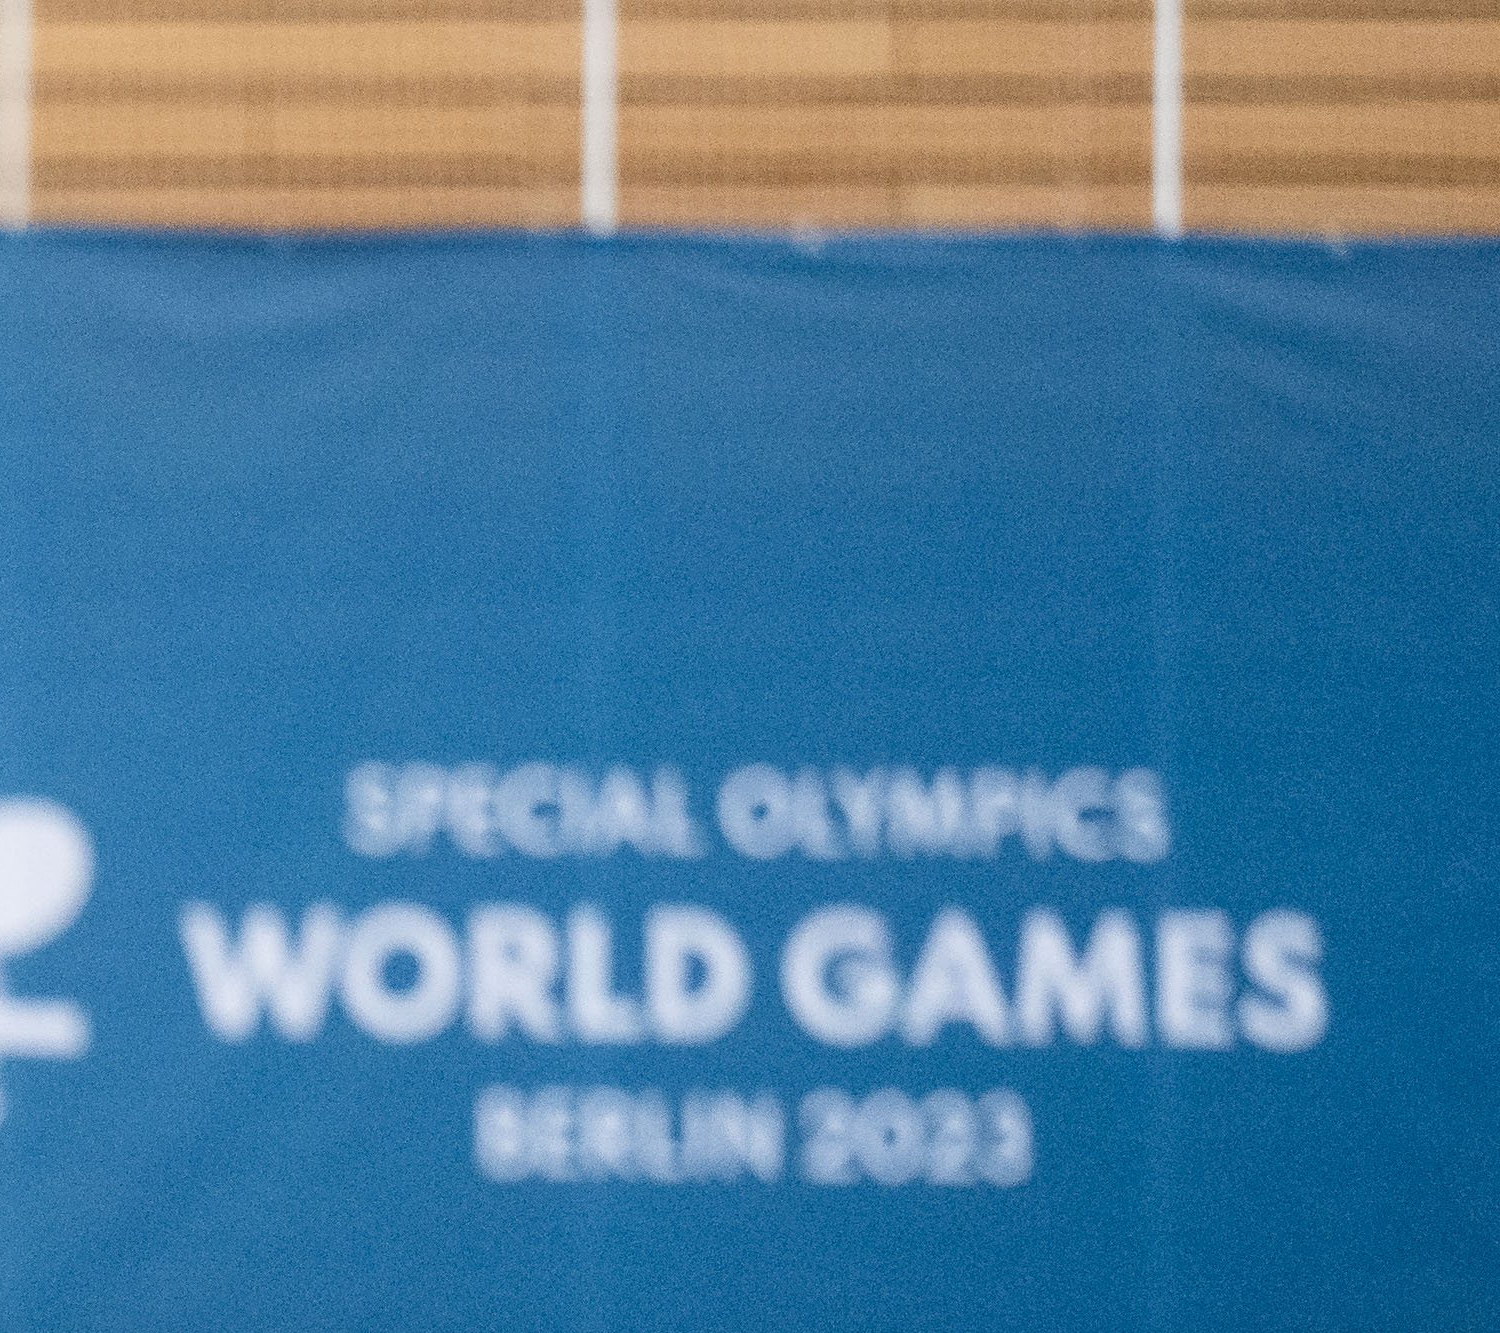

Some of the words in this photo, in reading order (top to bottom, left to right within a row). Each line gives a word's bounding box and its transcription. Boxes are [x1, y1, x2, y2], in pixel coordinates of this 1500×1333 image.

[343, 762, 703, 860] SPECIAL
[715, 763, 1169, 861] OLYMPICS
[179, 902, 751, 1044] WORLD
[781, 905, 1326, 1048] GAMES
[472, 1083, 786, 1182] BERLIN
[798, 1088, 1033, 1186] 2023
